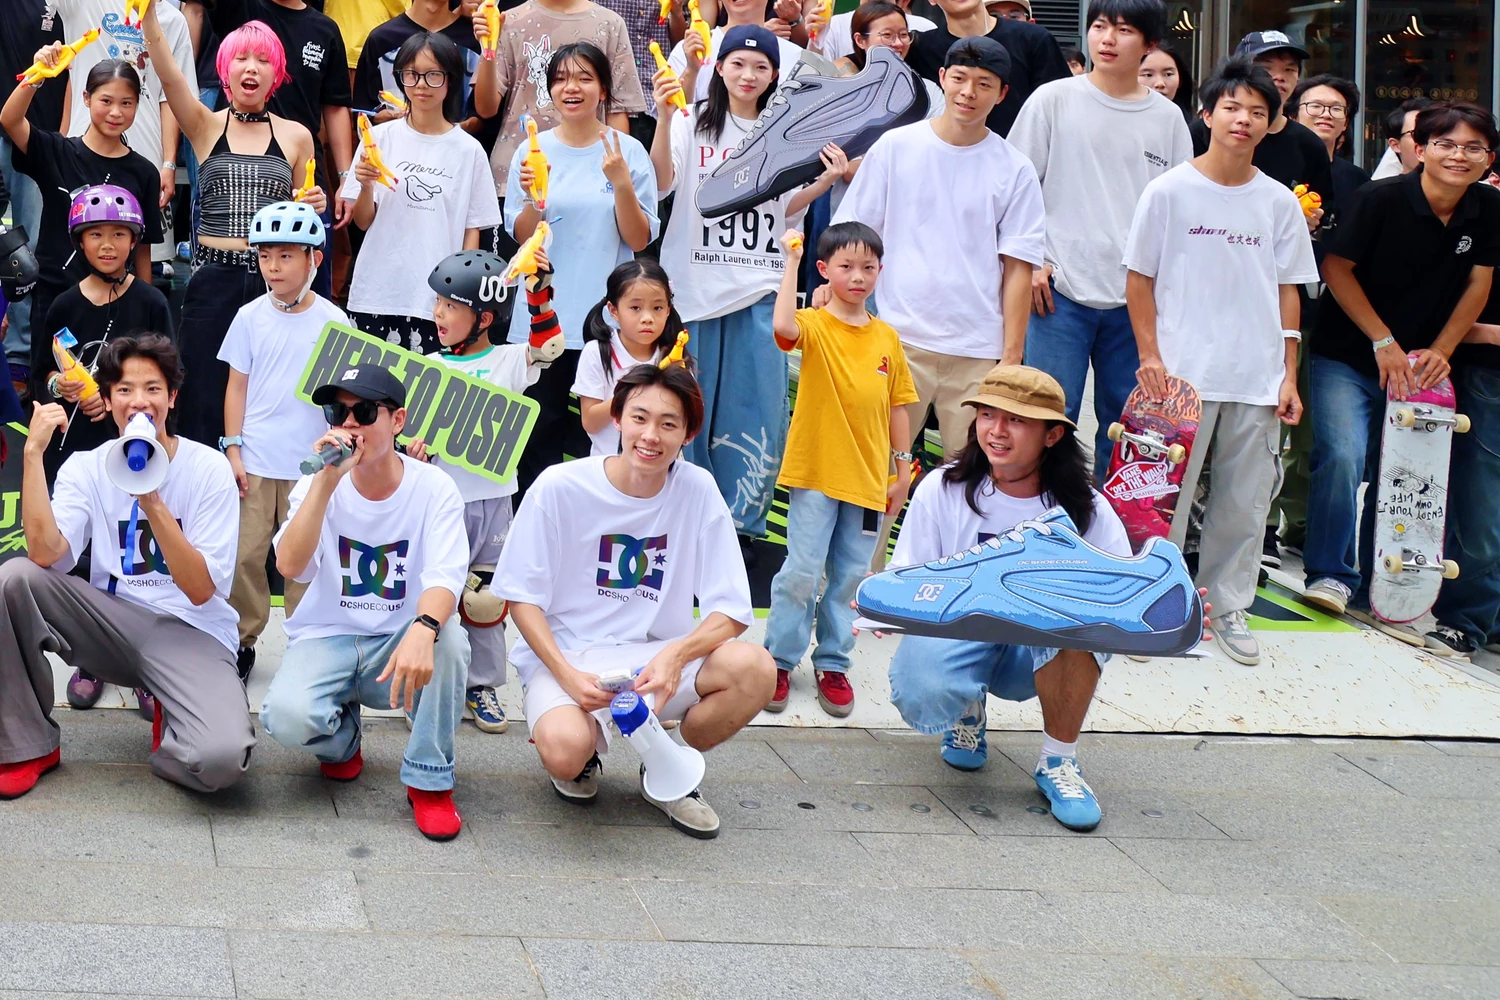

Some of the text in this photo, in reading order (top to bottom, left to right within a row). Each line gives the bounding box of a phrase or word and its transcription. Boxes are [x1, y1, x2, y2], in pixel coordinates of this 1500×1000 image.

[694, 251, 720, 263] Ralph
[723, 253, 751, 266] Lauren
[753, 257, 770, 268] est.
[402, 358, 443, 439] TO
[424, 375, 532, 477] PUSH
[1119, 464, 1143, 481] VANS
[1125, 475, 1146, 490] THE
[1134, 485, 1179, 498] SKATEBOARDING
[1390, 492, 1414, 504] LIFE
[1389, 505, 1444, 521] ENJOY YOUR
